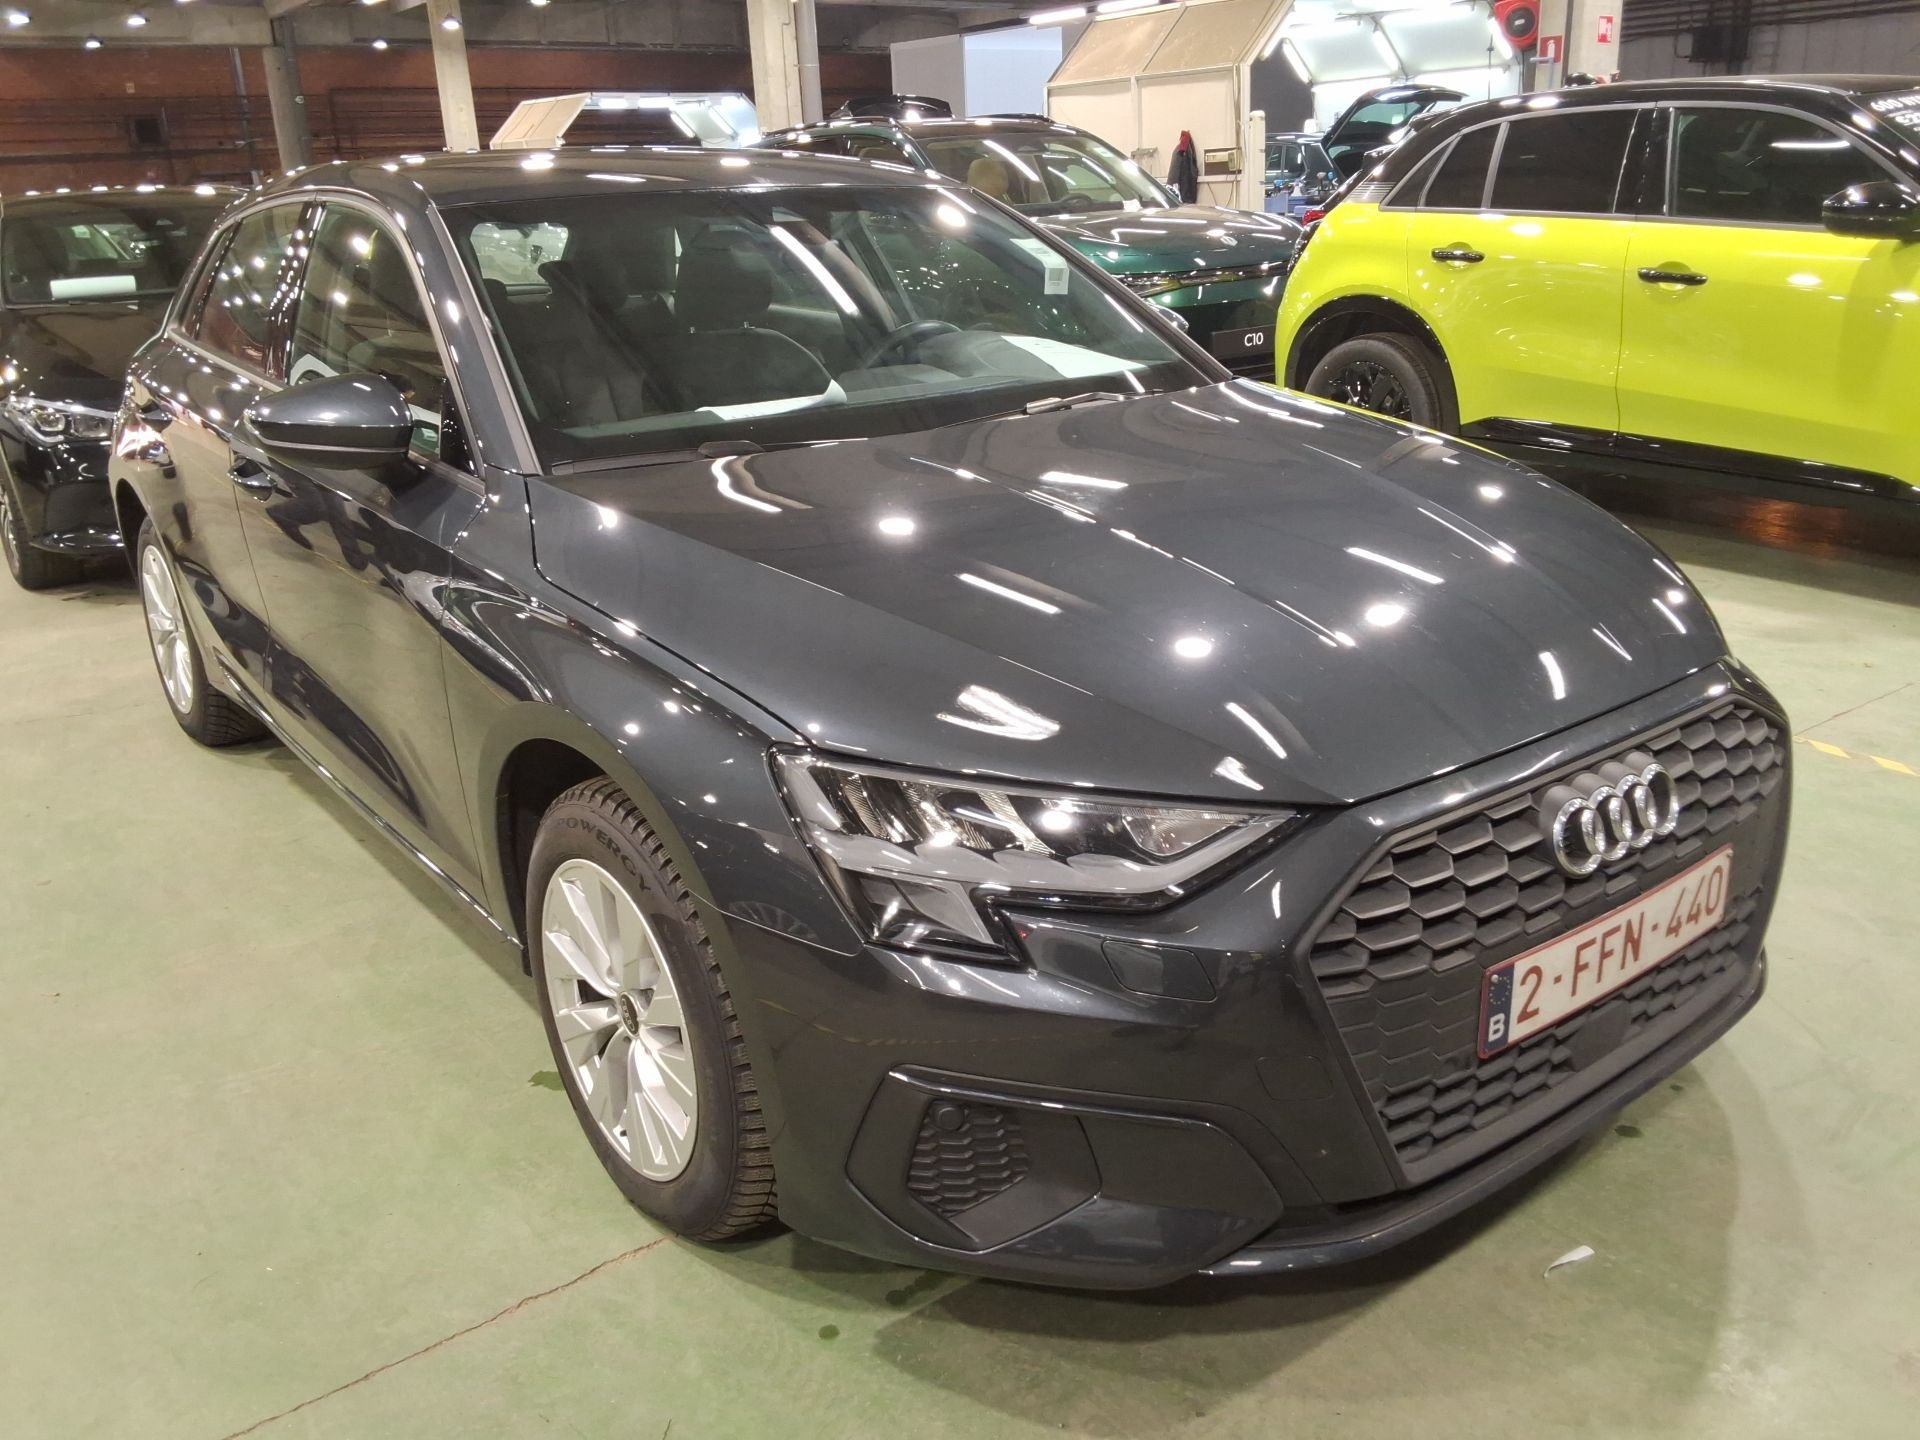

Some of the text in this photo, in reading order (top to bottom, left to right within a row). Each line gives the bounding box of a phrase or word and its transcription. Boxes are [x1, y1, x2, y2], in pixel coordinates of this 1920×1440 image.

[1244, 332, 1264, 347] C10
[1516, 865, 1724, 1025] 2-FFN-440
[1488, 1013, 1505, 1043] B
